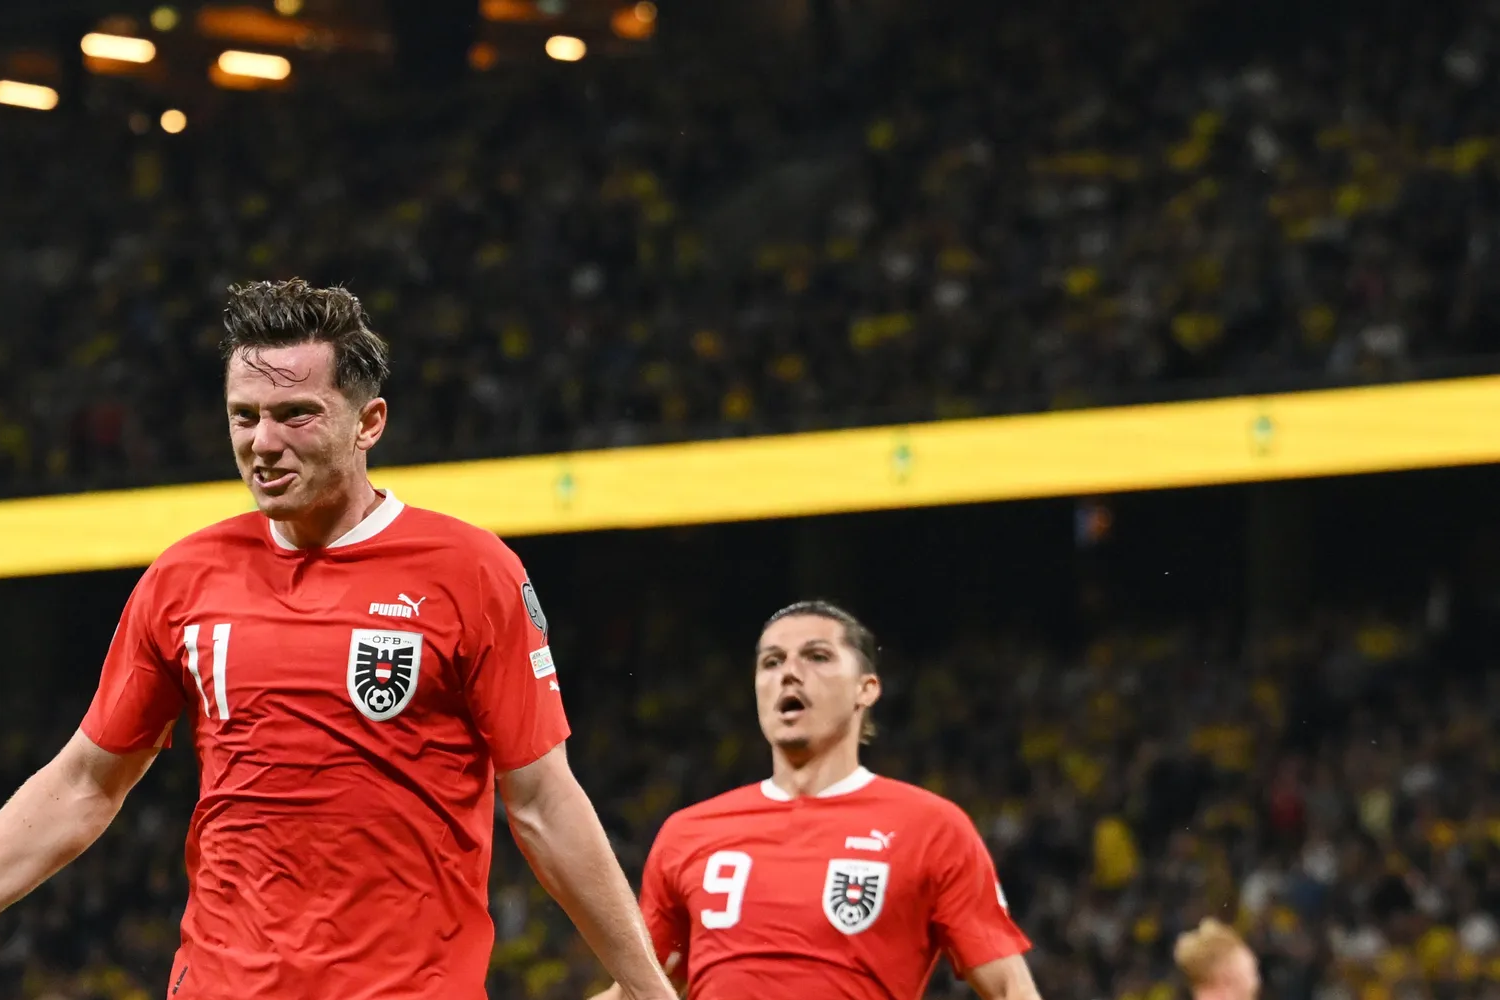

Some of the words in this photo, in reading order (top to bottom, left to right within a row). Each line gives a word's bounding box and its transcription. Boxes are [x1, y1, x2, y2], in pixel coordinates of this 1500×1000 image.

[369, 602, 412, 619] PUMA
[184, 623, 231, 720] 11
[701, 850, 753, 929] 9
